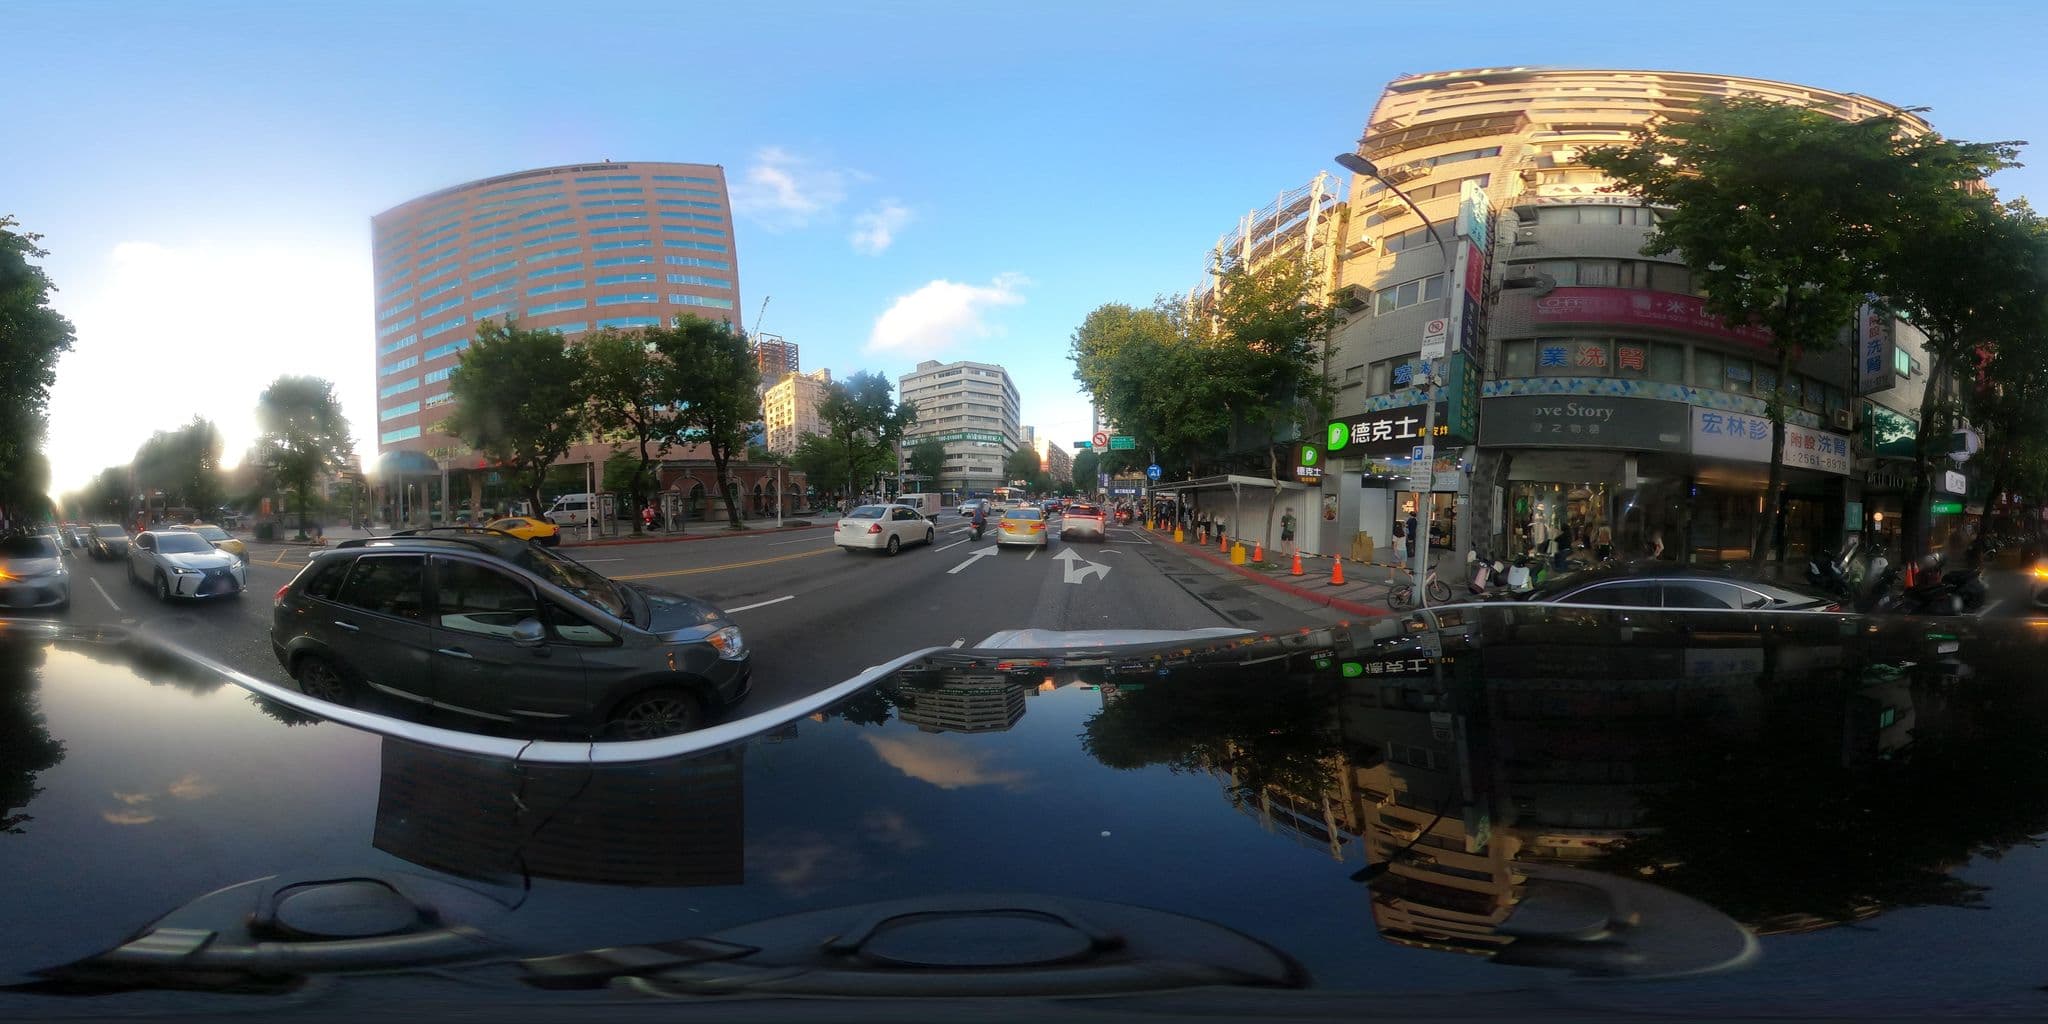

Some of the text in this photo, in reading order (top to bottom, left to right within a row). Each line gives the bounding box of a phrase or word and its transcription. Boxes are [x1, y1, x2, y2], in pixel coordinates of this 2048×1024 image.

[1566, 402, 1614, 422] Story
[1350, 416, 1418, 444] 德克士
